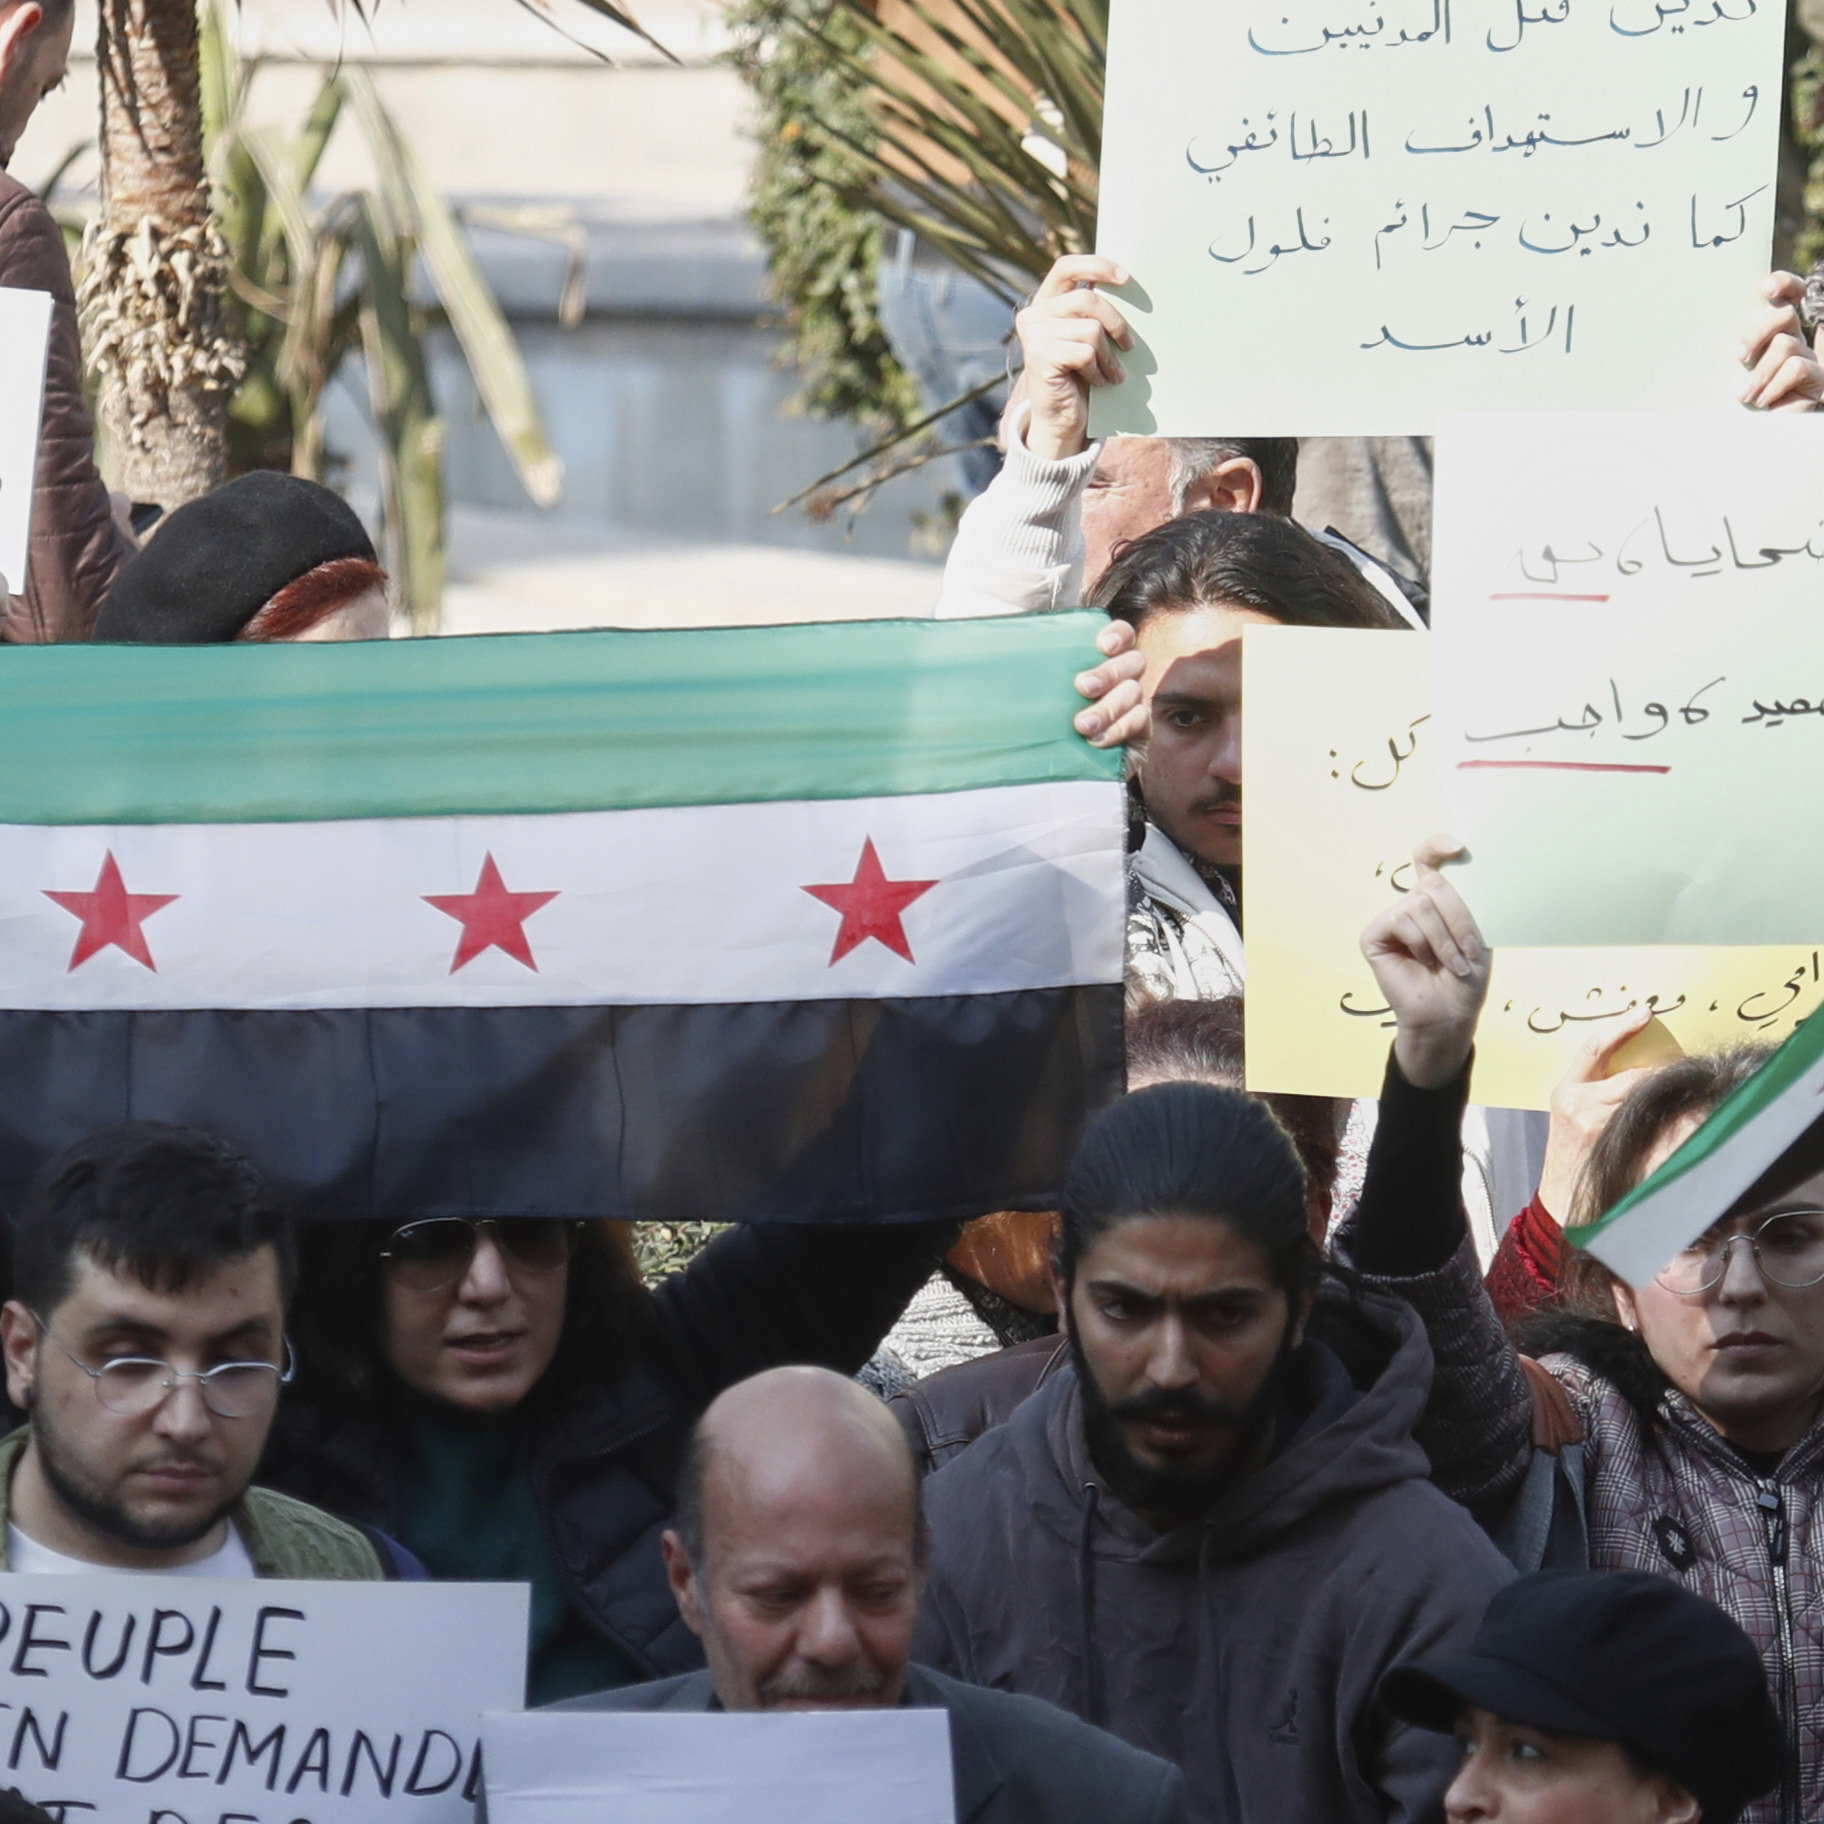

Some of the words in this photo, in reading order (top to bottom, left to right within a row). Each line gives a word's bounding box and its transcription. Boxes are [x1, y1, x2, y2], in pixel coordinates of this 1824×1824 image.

[1185, 106, 1370, 185] الطائفي
[1209, 206, 1331, 274] فلول
[1375, 199, 1501, 270] جرائم
[1519, 201, 1650, 257] ندين
[1692, 185, 1768, 250] كما
[1359, 295, 1576, 354] الأسد
